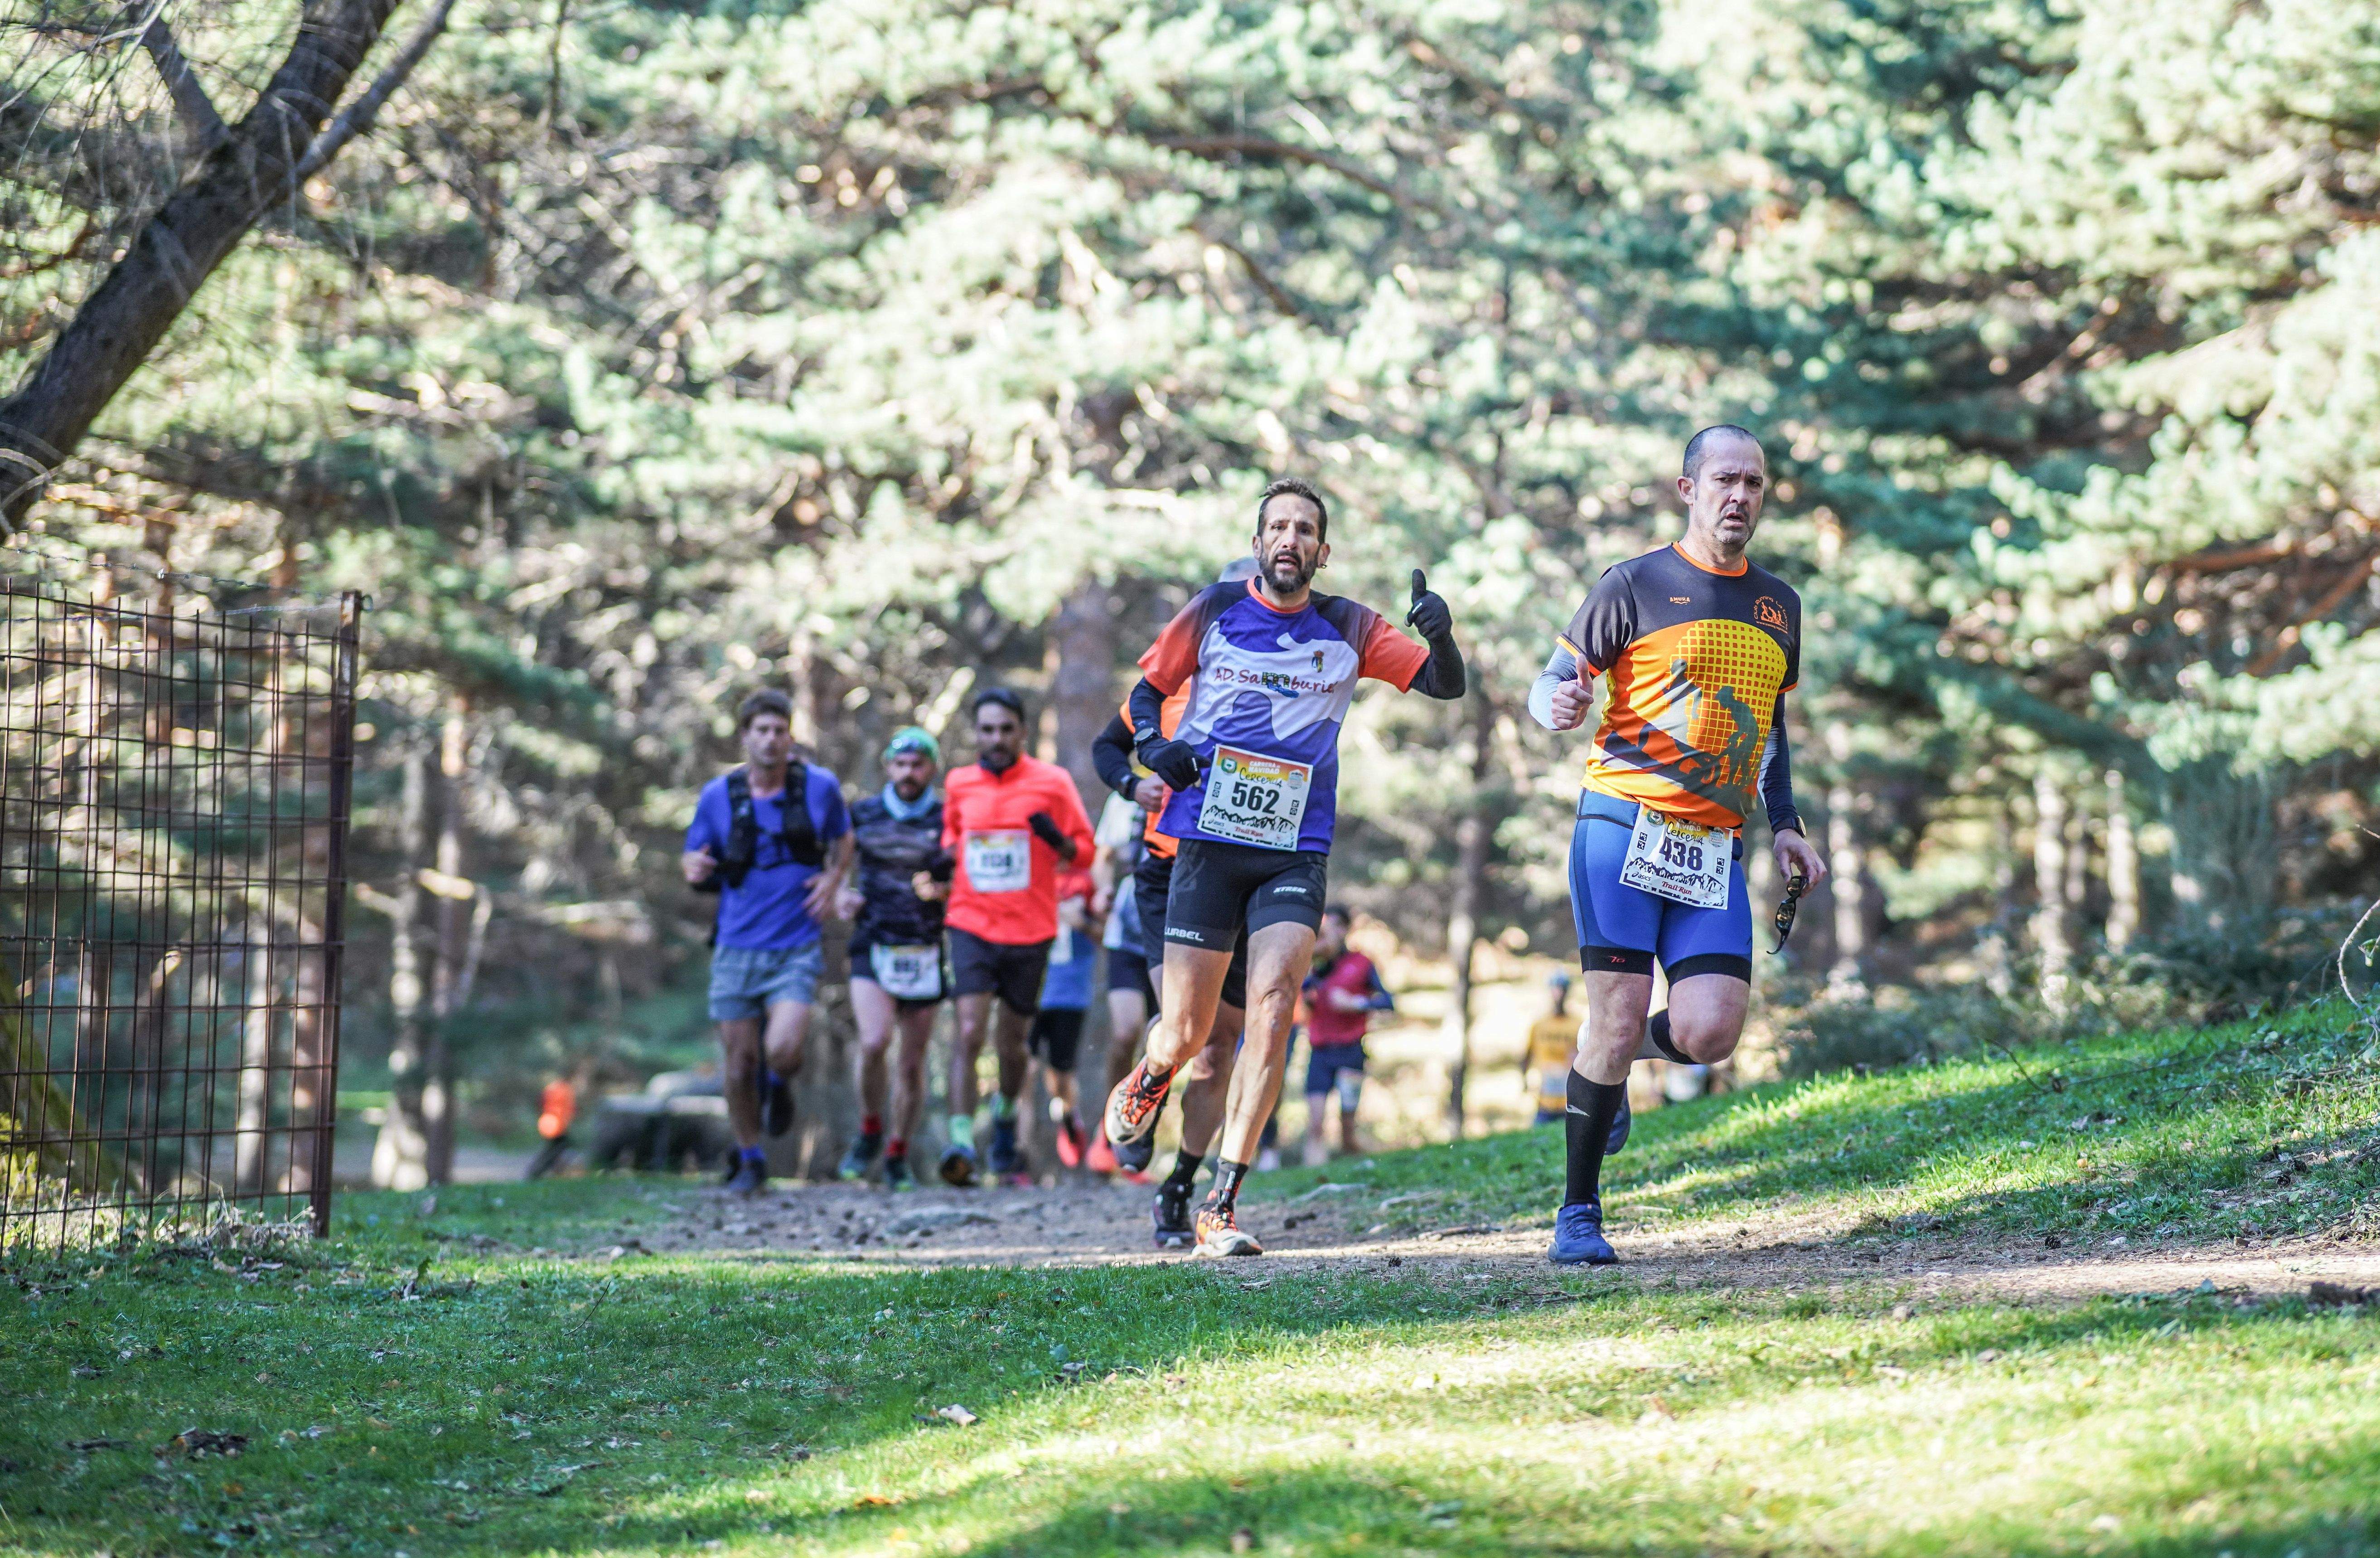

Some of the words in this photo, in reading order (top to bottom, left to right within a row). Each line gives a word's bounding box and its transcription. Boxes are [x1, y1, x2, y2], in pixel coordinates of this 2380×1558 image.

[1231, 781, 1280, 815] 562
[1659, 836, 1703, 871] 438
[1662, 881, 1678, 891] Trail
[1678, 886, 1692, 895] Run
